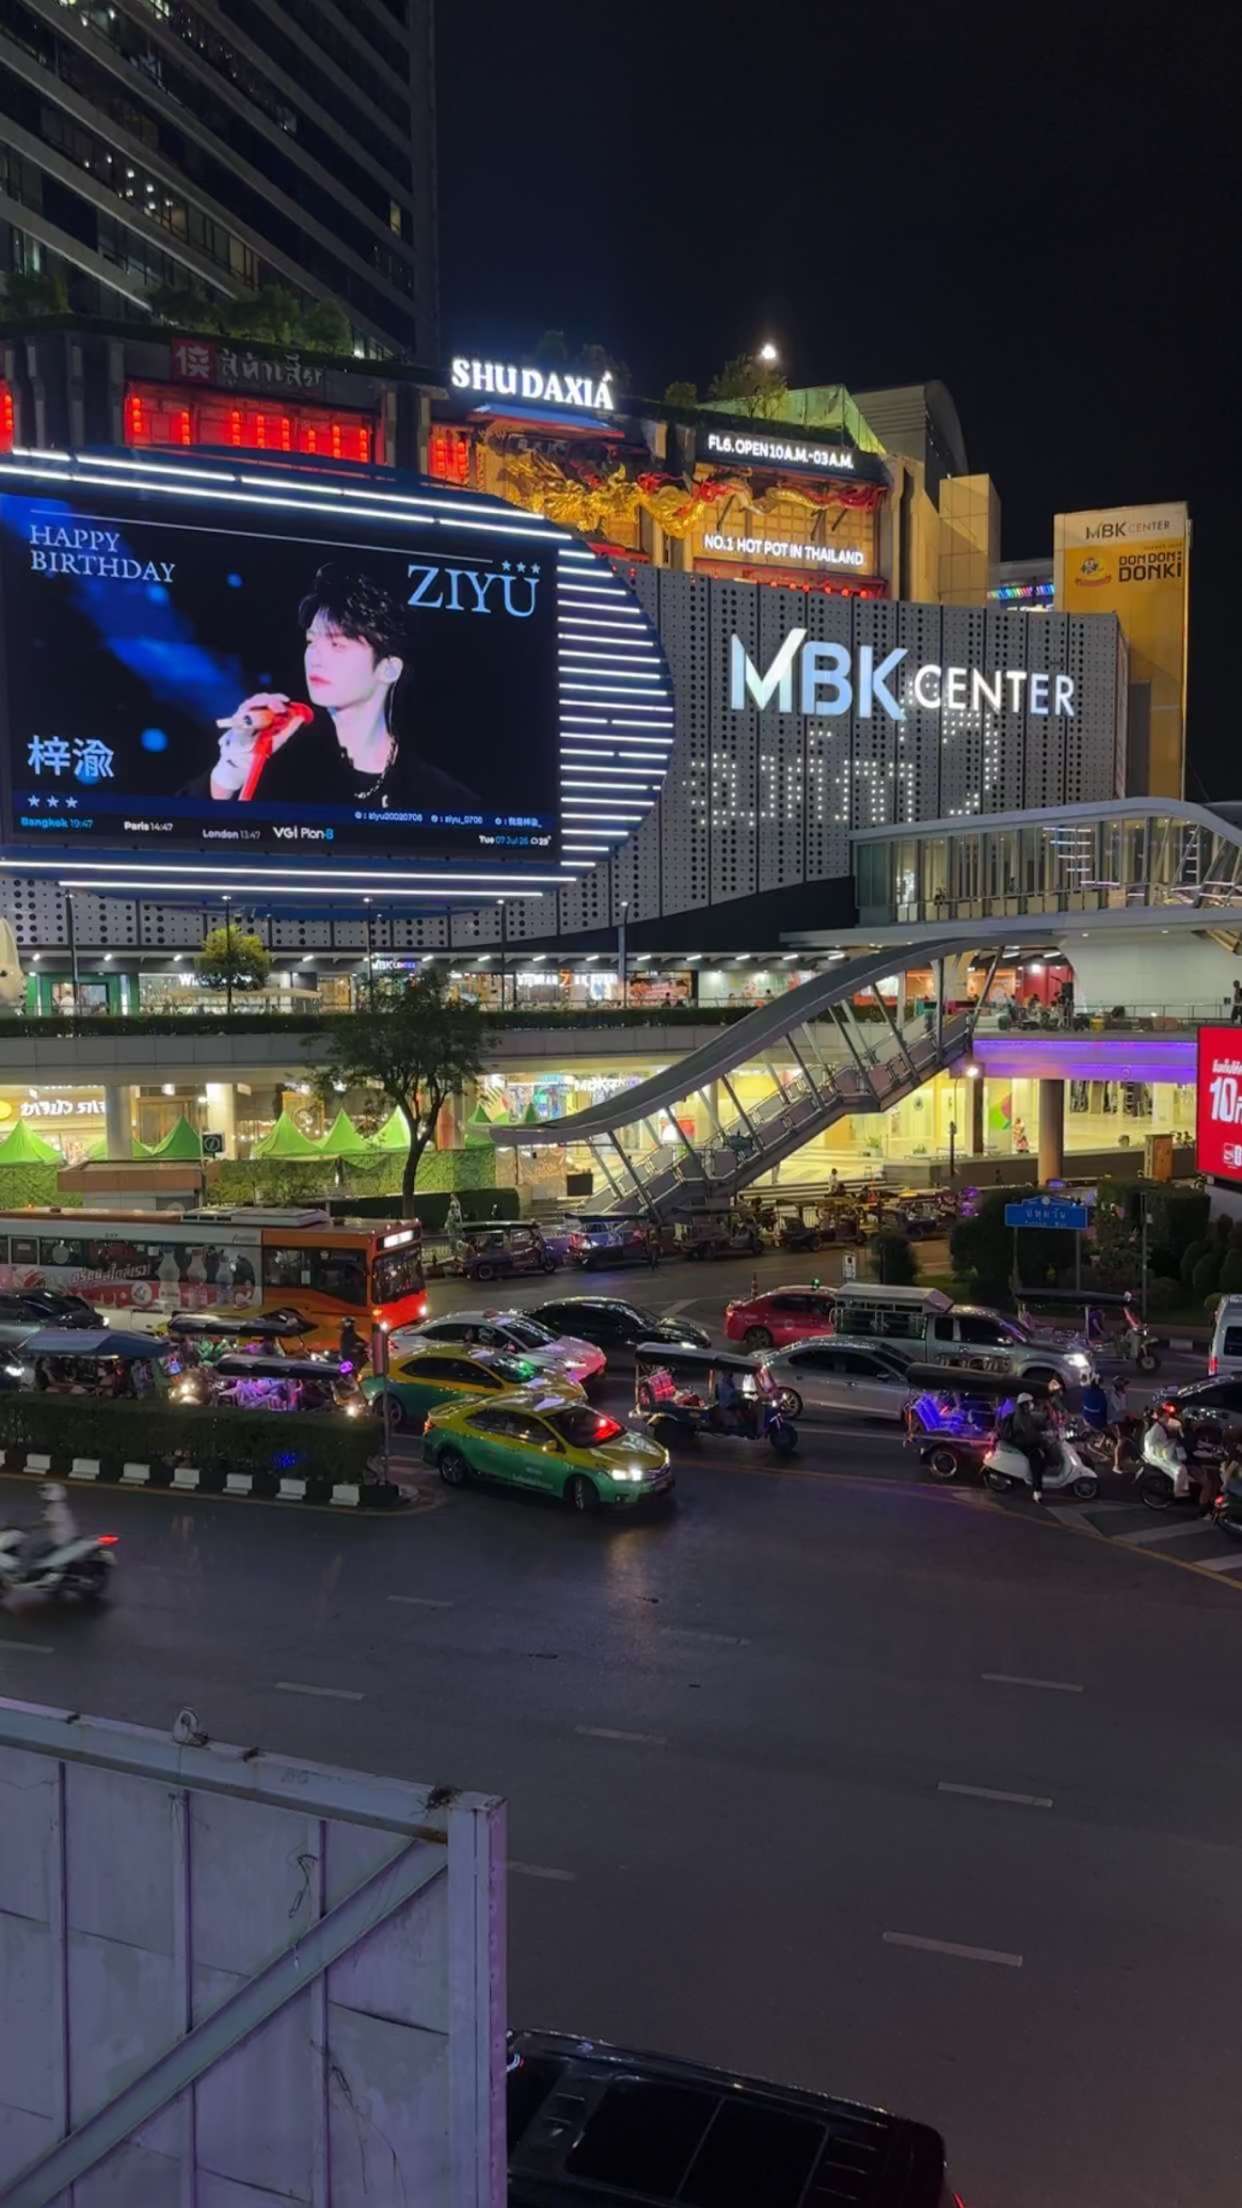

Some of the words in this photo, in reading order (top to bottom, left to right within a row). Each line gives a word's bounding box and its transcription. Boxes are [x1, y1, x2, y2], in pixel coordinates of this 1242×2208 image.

[451, 356, 518, 396] SHU
[735, 438, 769, 457] OPEN
[30, 524, 121, 552] HAPPY
[1085, 521, 1127, 540] MBK
[1128, 520, 1171, 534] CENTER
[704, 535, 734, 550] NO.1
[737, 538, 762, 553] HOT
[764, 541, 790, 556] POT
[791, 545, 802, 559] IN
[804, 545, 864, 566] THAILAND
[1119, 554, 1146, 566] DON
[1148, 552, 1176, 564] DON
[30, 549, 176, 583] BIRTHDAY
[1118, 562, 1182, 583] DONKI
[407, 564, 540, 617] ZIYU
[731, 628, 909, 721] MBK
[914, 663, 1075, 718] CENTER
[27, 734, 115, 777] 梓渝
[20, 816, 69, 829] Bangkok
[124, 821, 150, 832] Paris
[150, 822, 174, 832] 14:47
[202, 829, 239, 839] London
[478, 834, 495, 845] Tue
